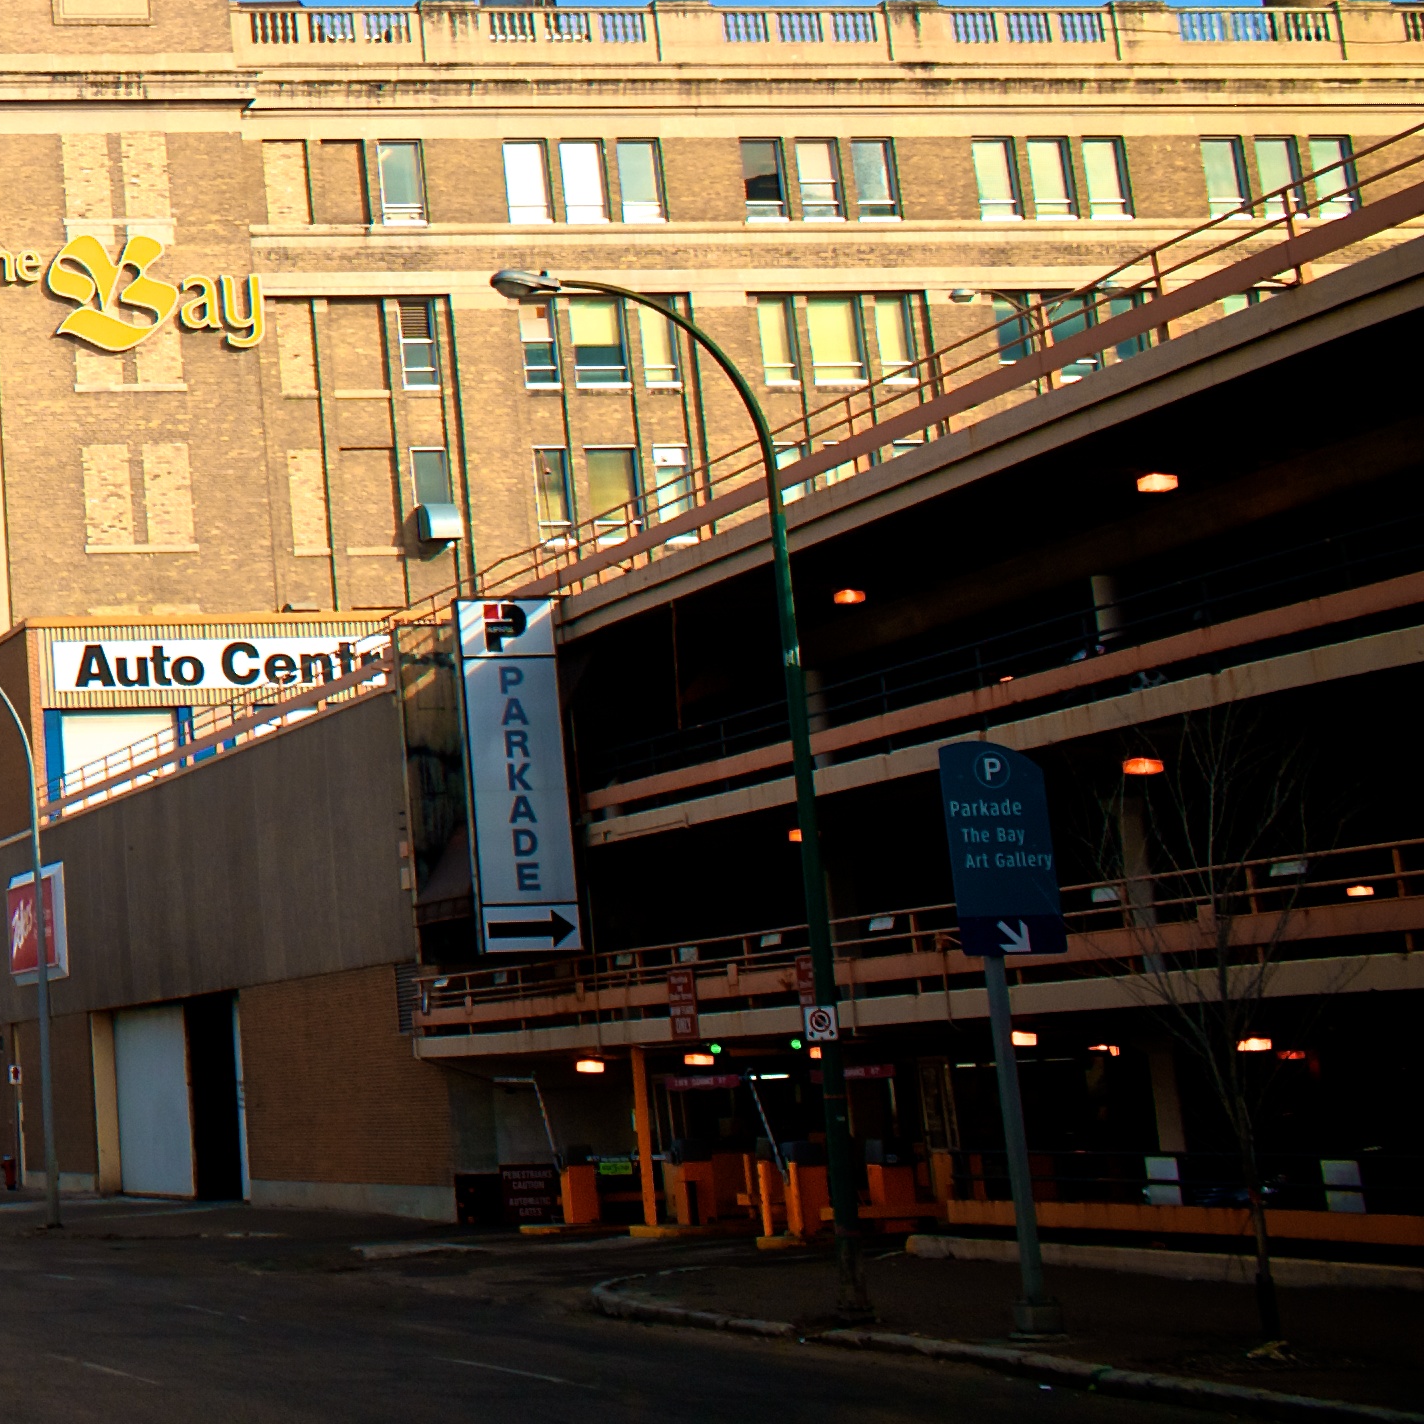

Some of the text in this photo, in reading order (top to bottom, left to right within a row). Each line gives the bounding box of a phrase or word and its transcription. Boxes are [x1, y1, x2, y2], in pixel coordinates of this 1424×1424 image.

[47, 235, 265, 351] Bay
[75, 643, 205, 688] Auto
[499, 666, 542, 897] PARKADE
[949, 798, 1022, 818] Parkade
[960, 827, 1025, 846] The Bay
[965, 851, 1052, 871] Art Gallery
